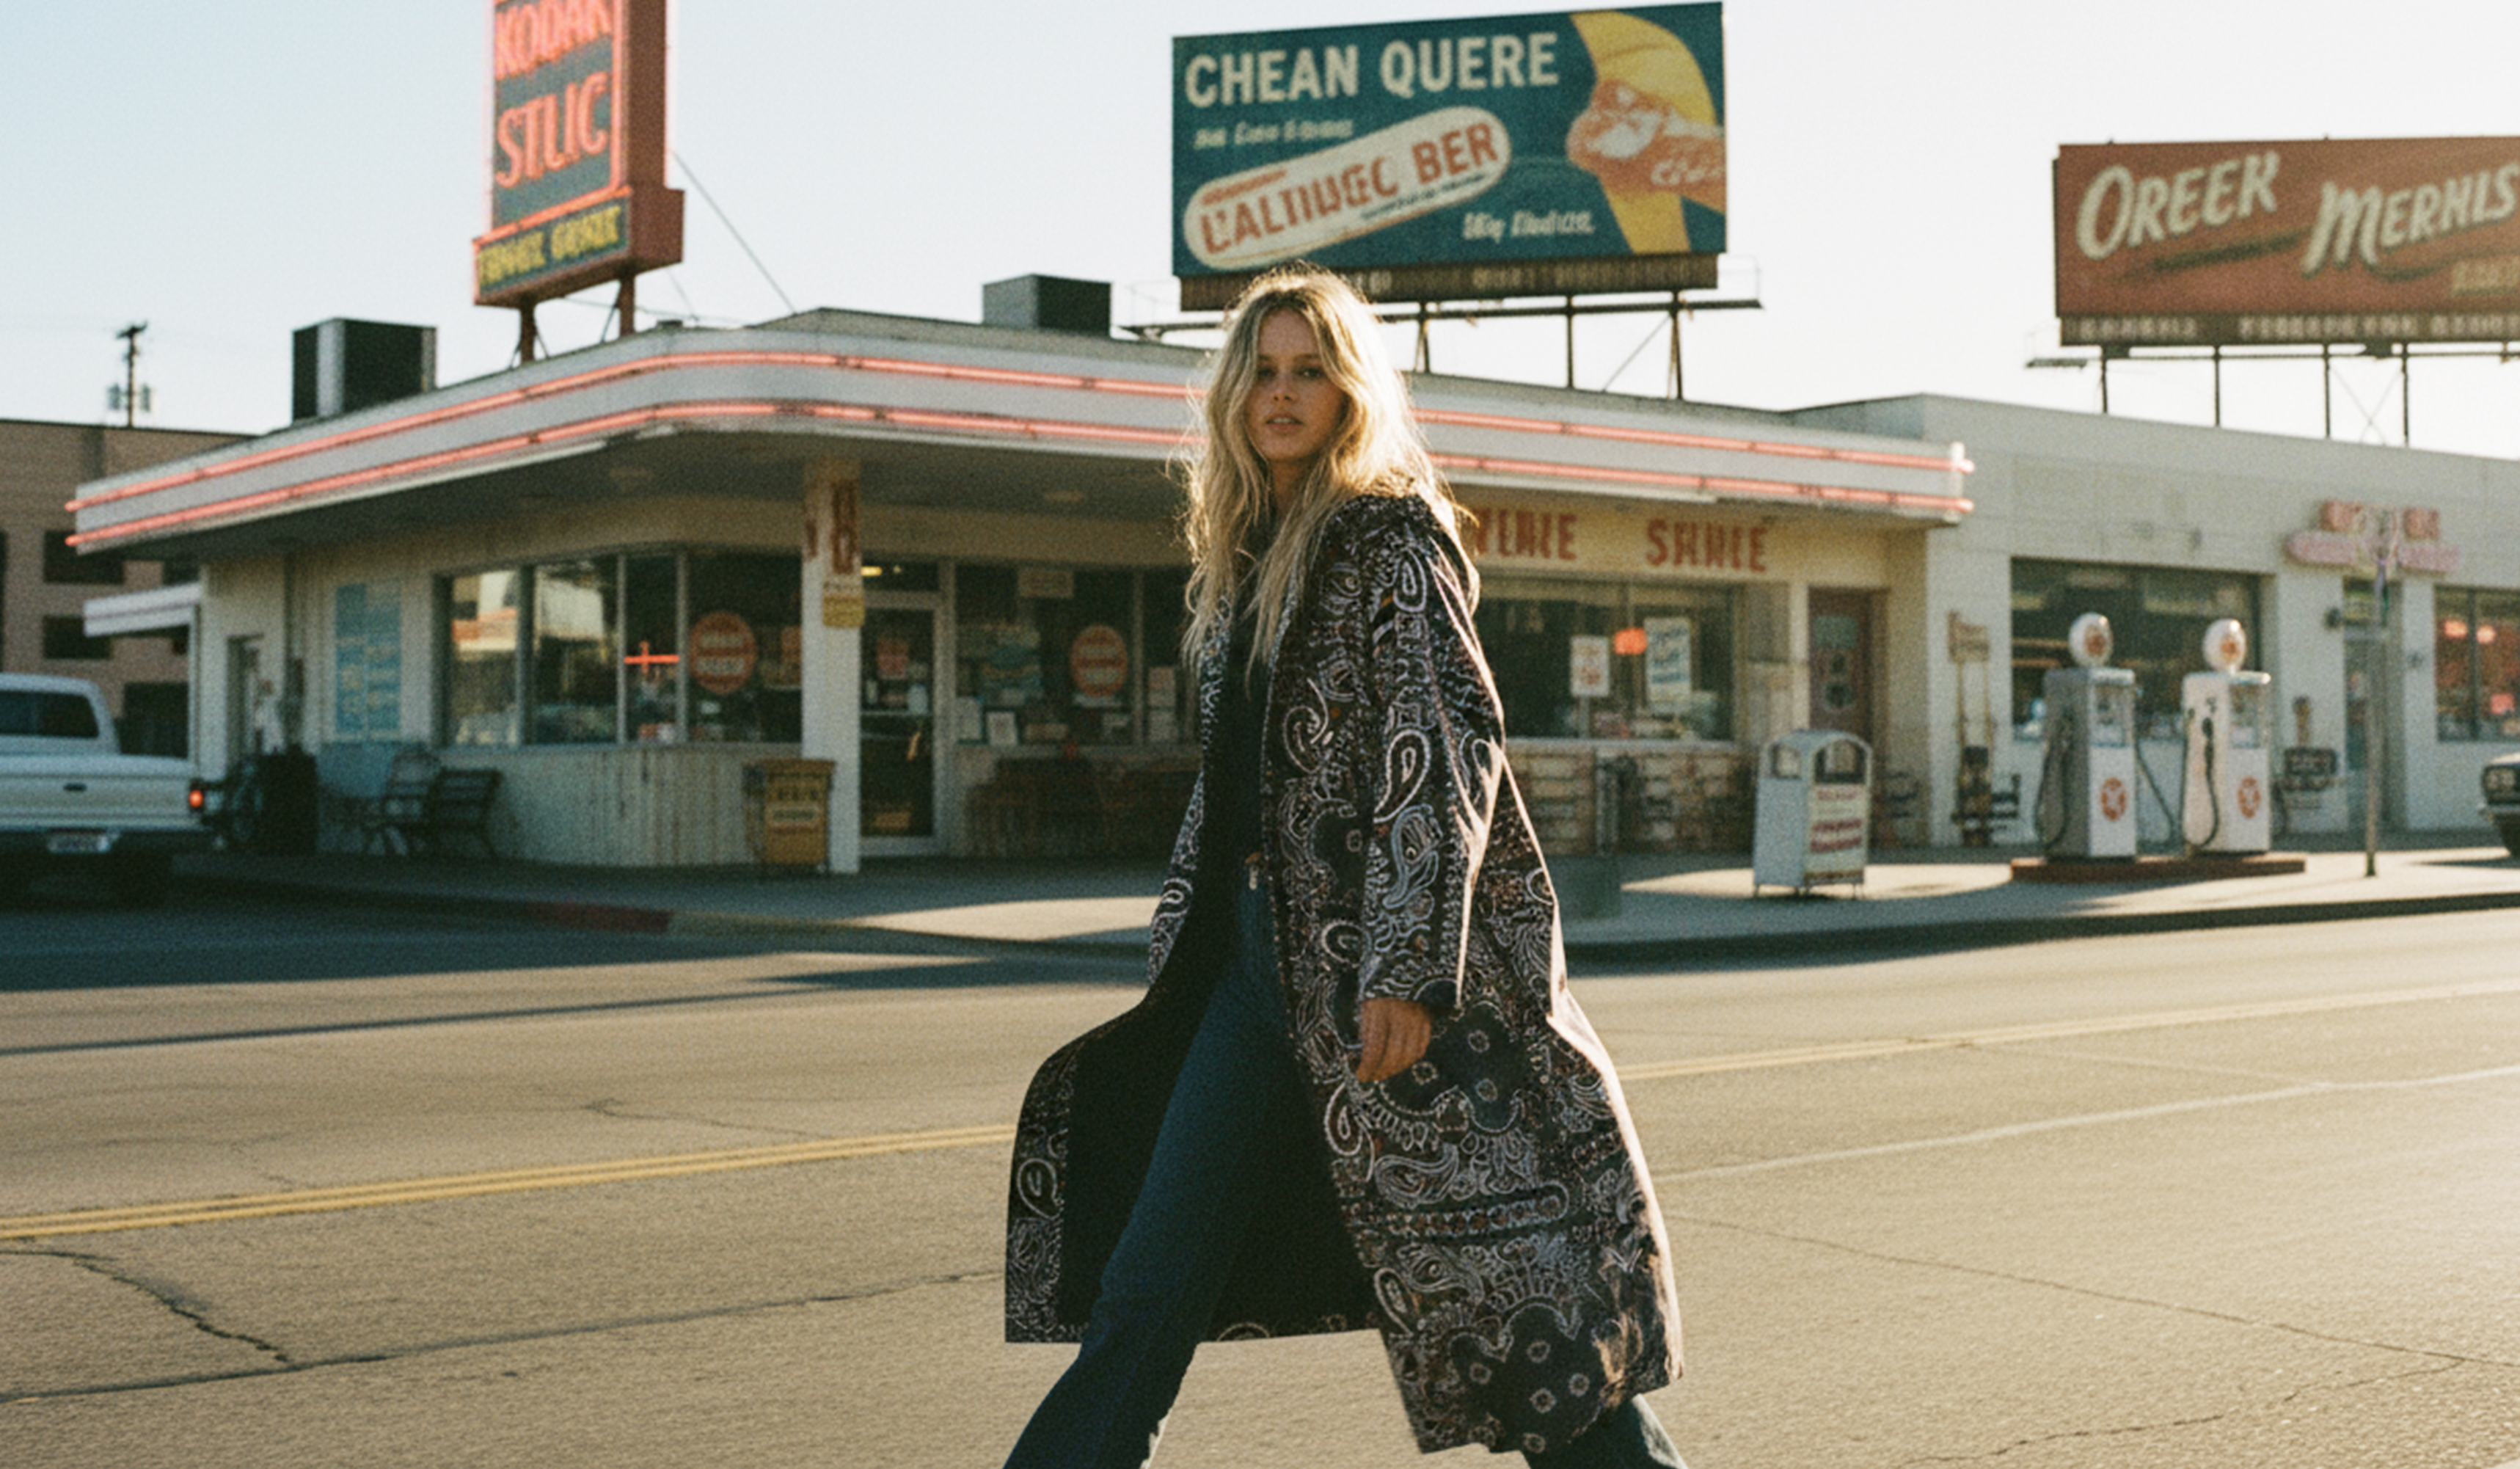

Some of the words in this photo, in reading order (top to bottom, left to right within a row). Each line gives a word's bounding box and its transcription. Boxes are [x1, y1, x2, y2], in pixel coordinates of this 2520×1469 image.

[1185, 45, 1358, 108] CHEAN
[1380, 32, 1559, 98] QUERE
[1411, 123, 1499, 184] BER
[2075, 151, 2279, 260] OREEK
